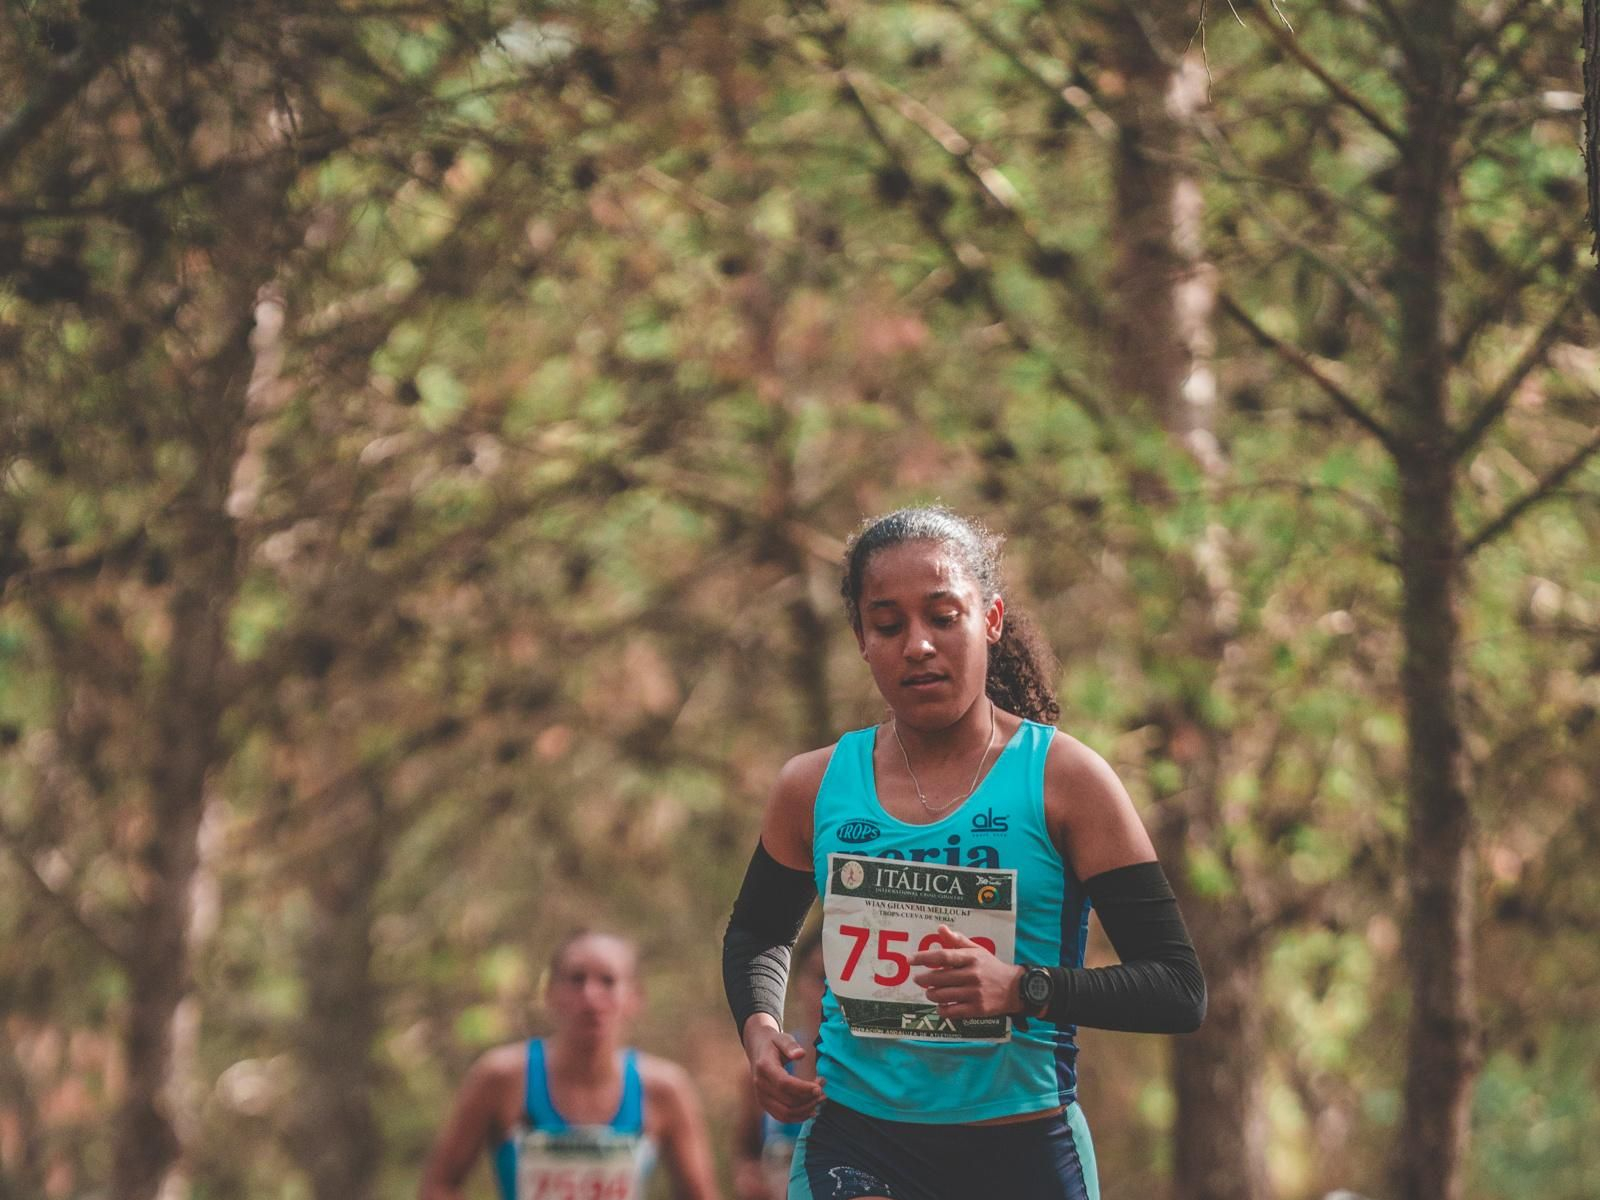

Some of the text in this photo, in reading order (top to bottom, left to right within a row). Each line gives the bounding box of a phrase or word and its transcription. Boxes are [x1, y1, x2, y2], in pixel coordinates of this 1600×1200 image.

[838, 823, 879, 840] TROPS
[971, 807, 1008, 832] als
[874, 866, 965, 896] ITÁLICA
[865, 900, 886, 909] WIAN
[887, 902, 926, 913] GHANEMI
[839, 924, 996, 989] 75
